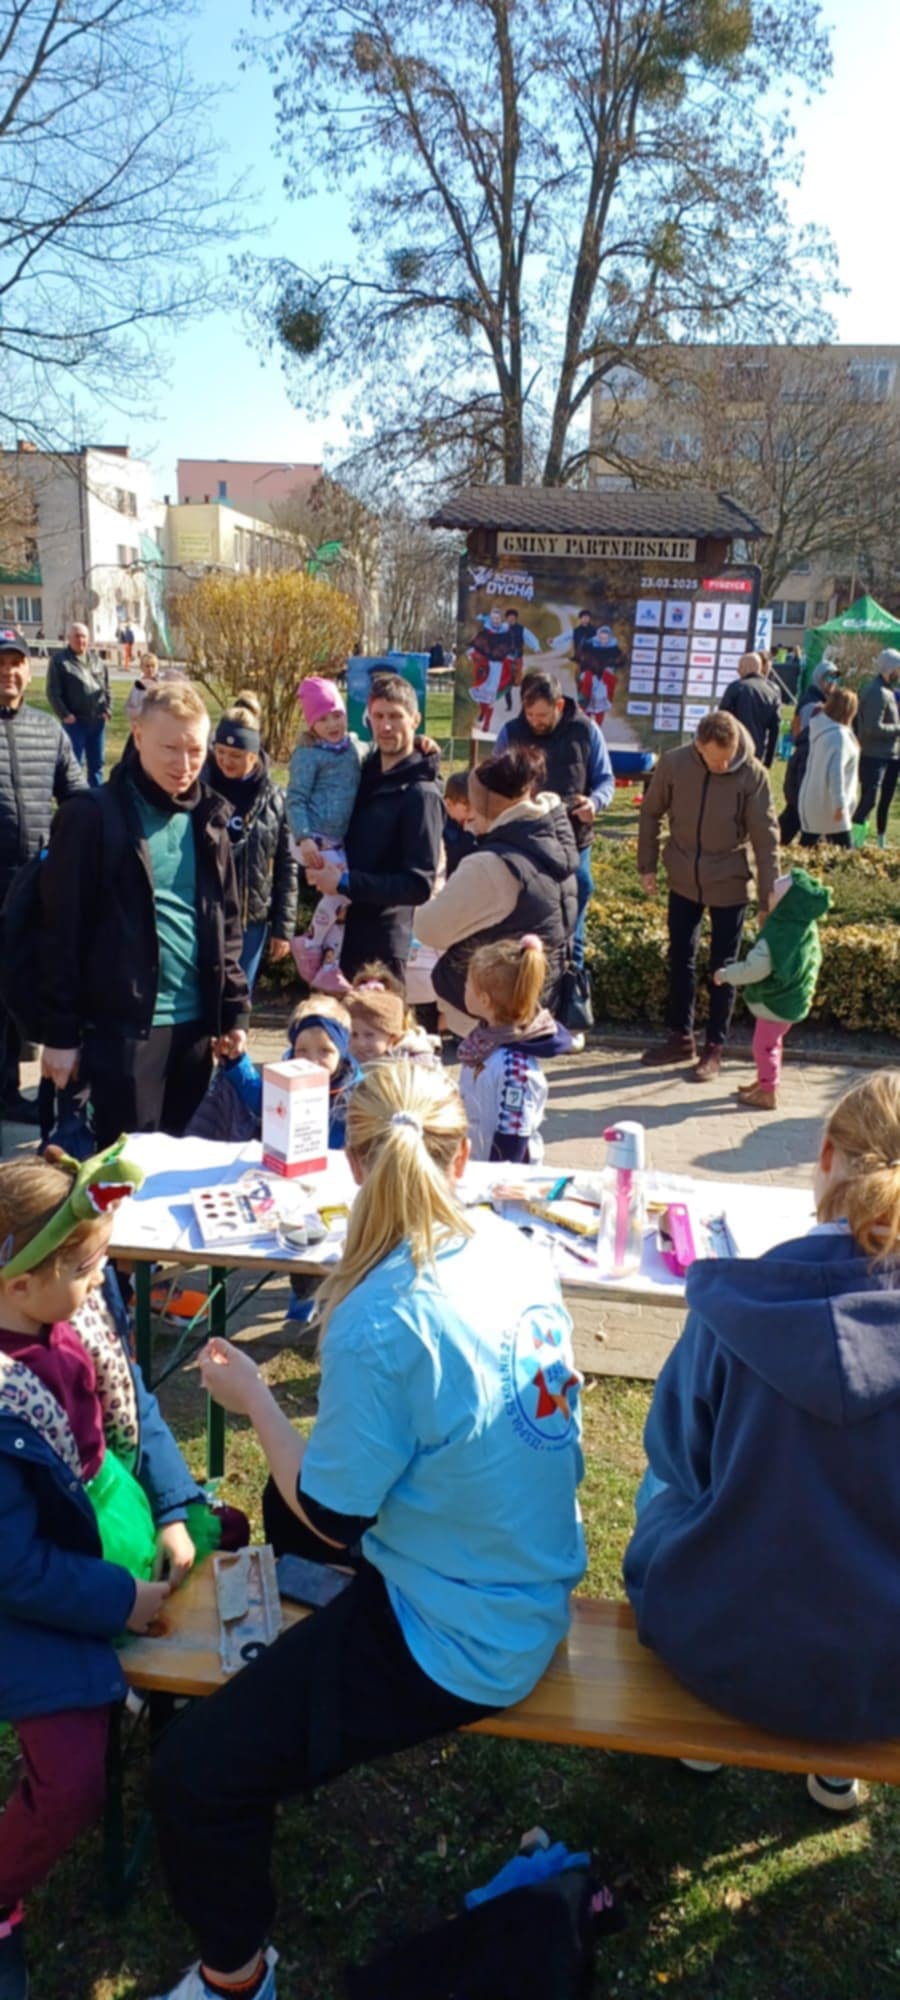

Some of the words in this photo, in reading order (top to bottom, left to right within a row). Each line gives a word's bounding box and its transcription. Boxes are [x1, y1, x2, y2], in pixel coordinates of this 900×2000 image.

[503, 536, 560, 553] GMINY
[566, 538, 691, 558] PARTNERSKIE
[486, 581, 535, 601] DYCHĄ
